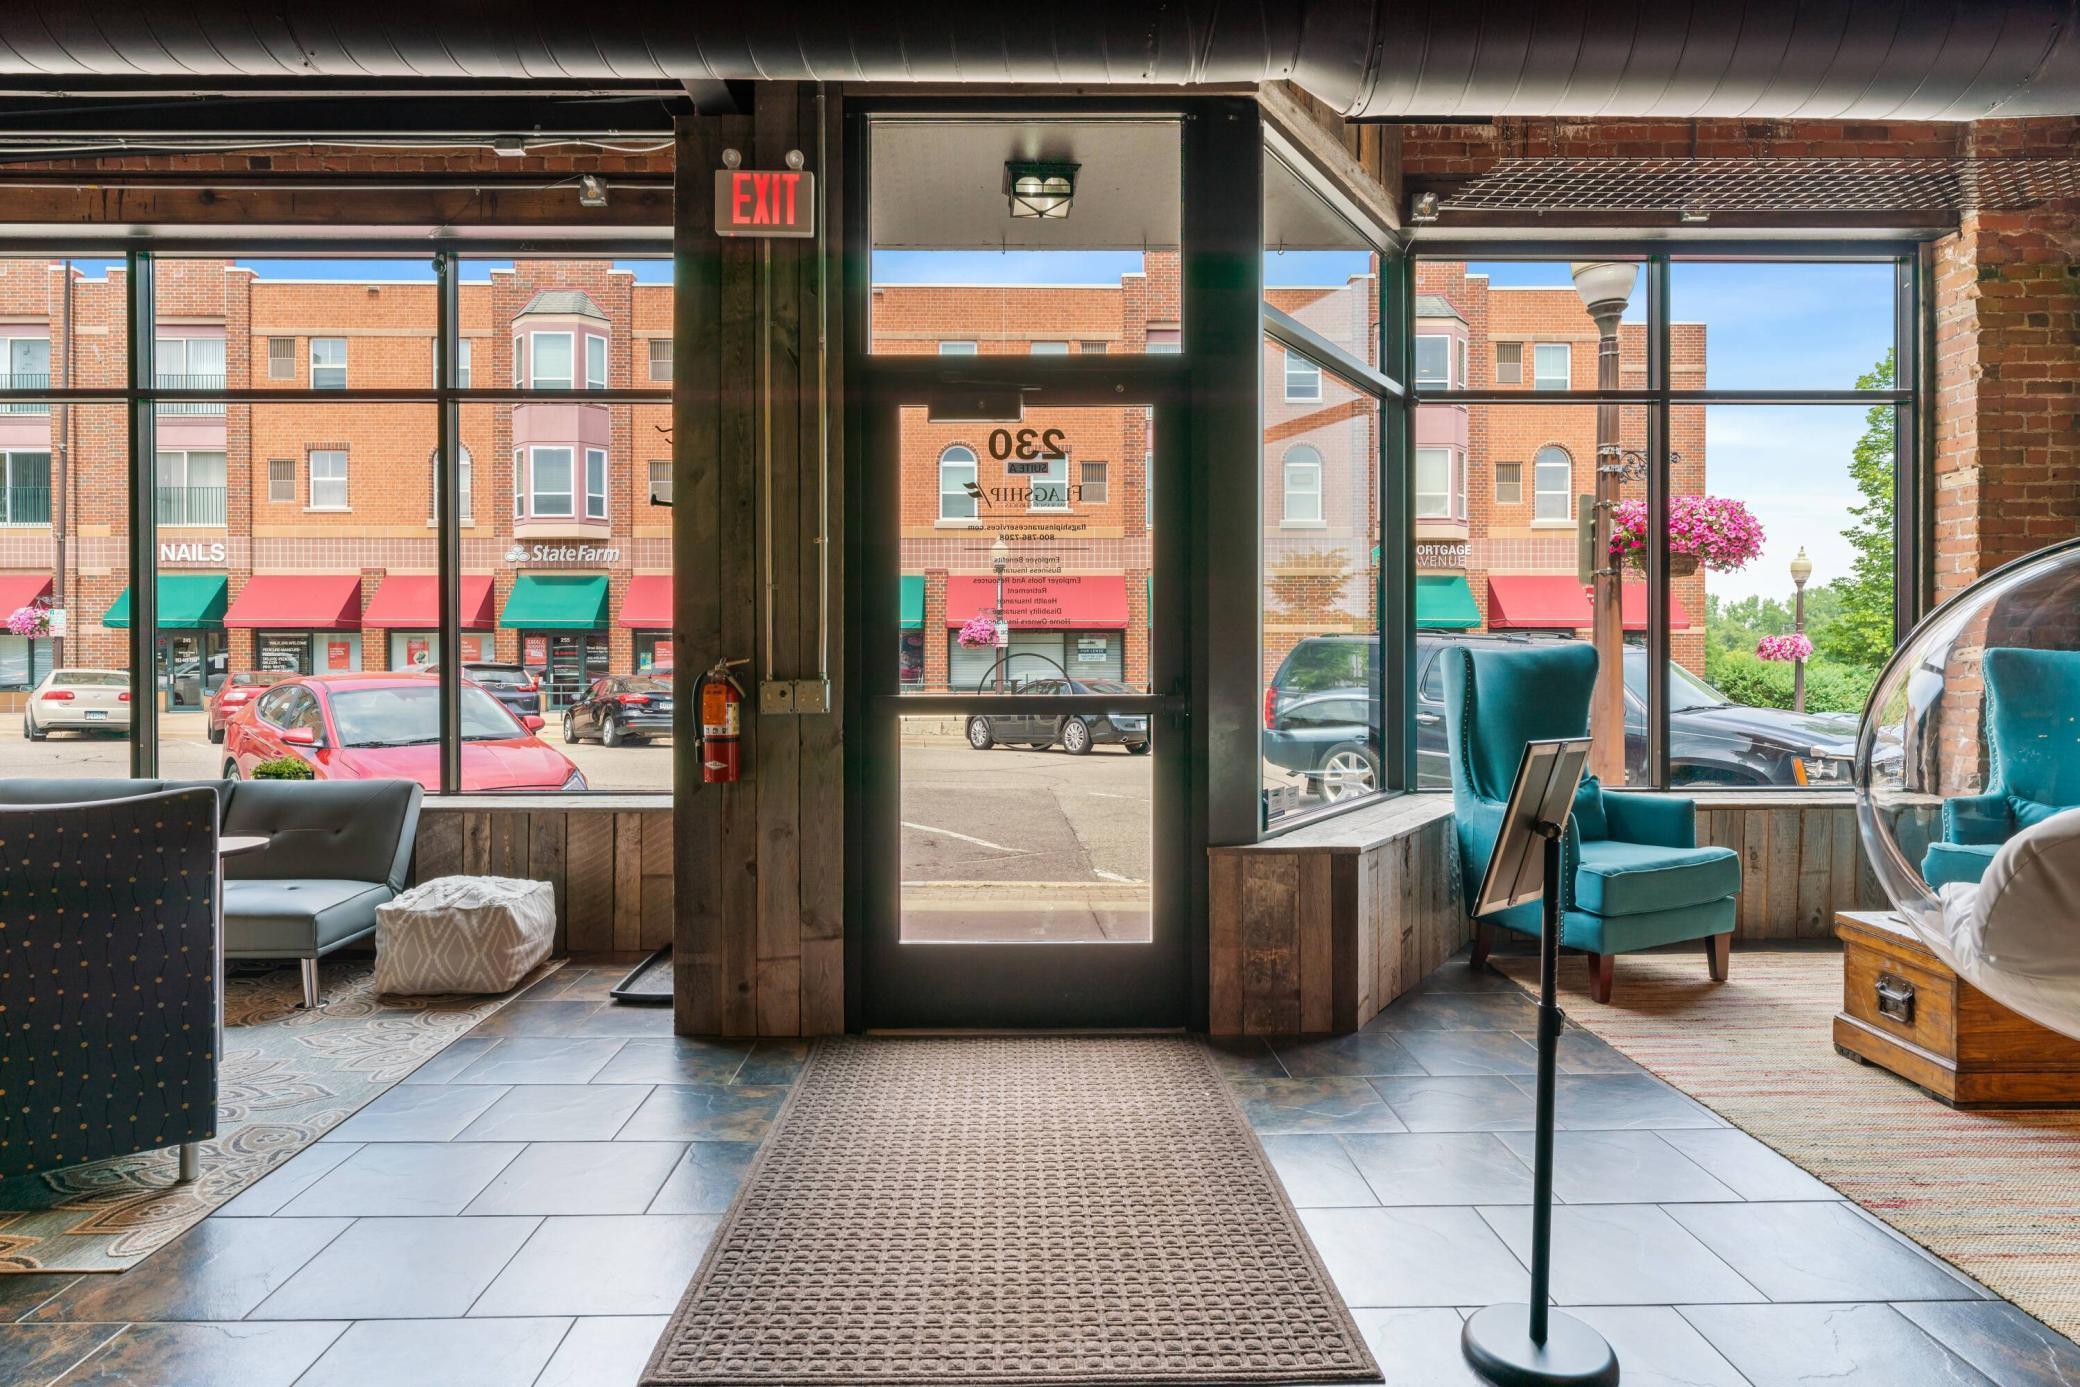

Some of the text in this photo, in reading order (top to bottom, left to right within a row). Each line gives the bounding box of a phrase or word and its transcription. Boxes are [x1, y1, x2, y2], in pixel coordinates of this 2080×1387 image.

[732, 173, 800, 224] EXIT
[160, 543, 225, 562] NAILS
[1416, 544, 1472, 555] ORTGAGE
